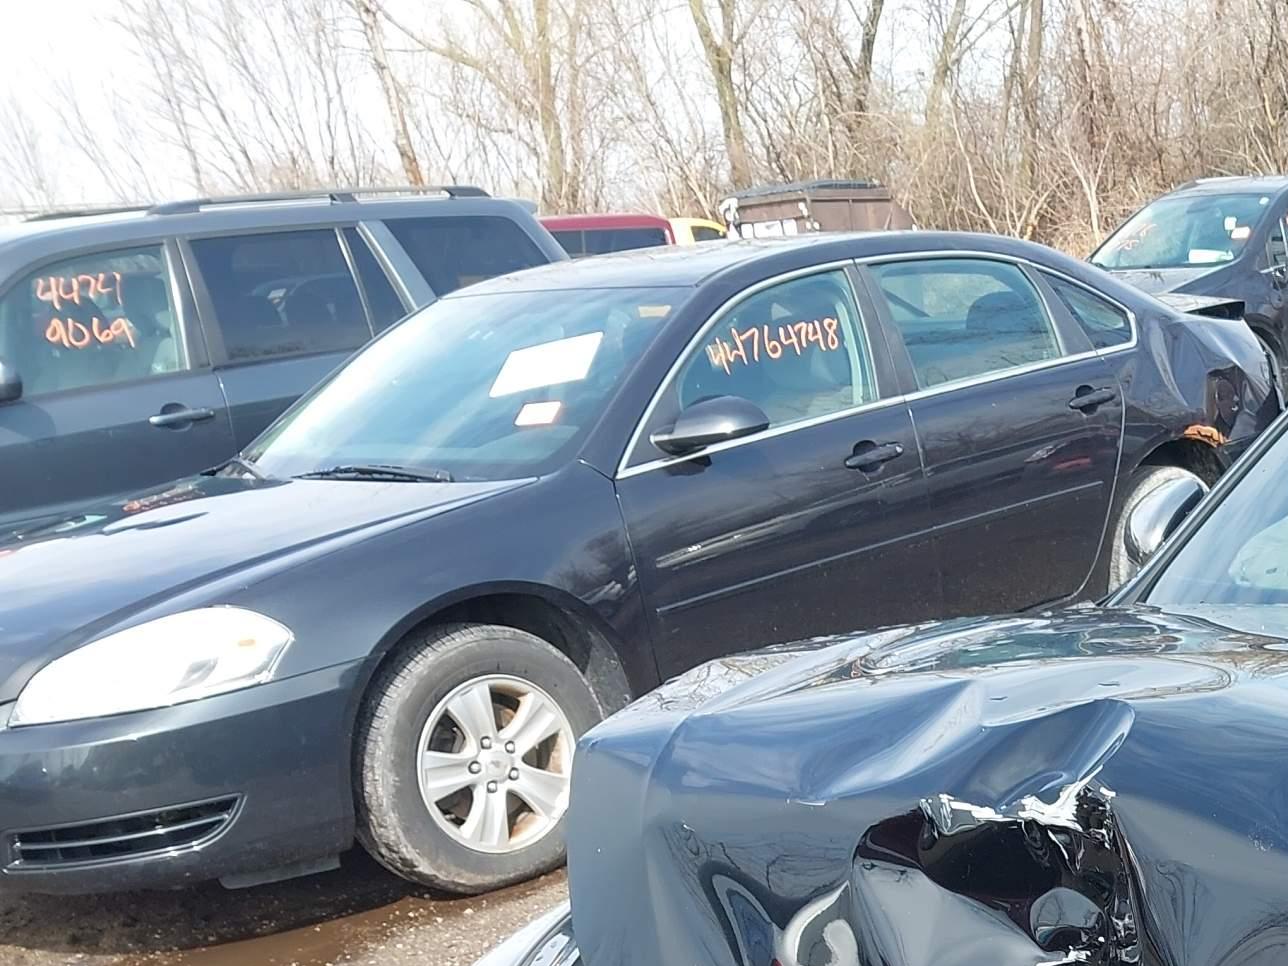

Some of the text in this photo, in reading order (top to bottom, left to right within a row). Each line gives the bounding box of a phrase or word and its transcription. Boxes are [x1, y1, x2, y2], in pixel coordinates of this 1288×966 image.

[35, 271, 122, 310] 4474
[45, 316, 136, 349] 9069
[704, 317, 839, 376] 44764748
